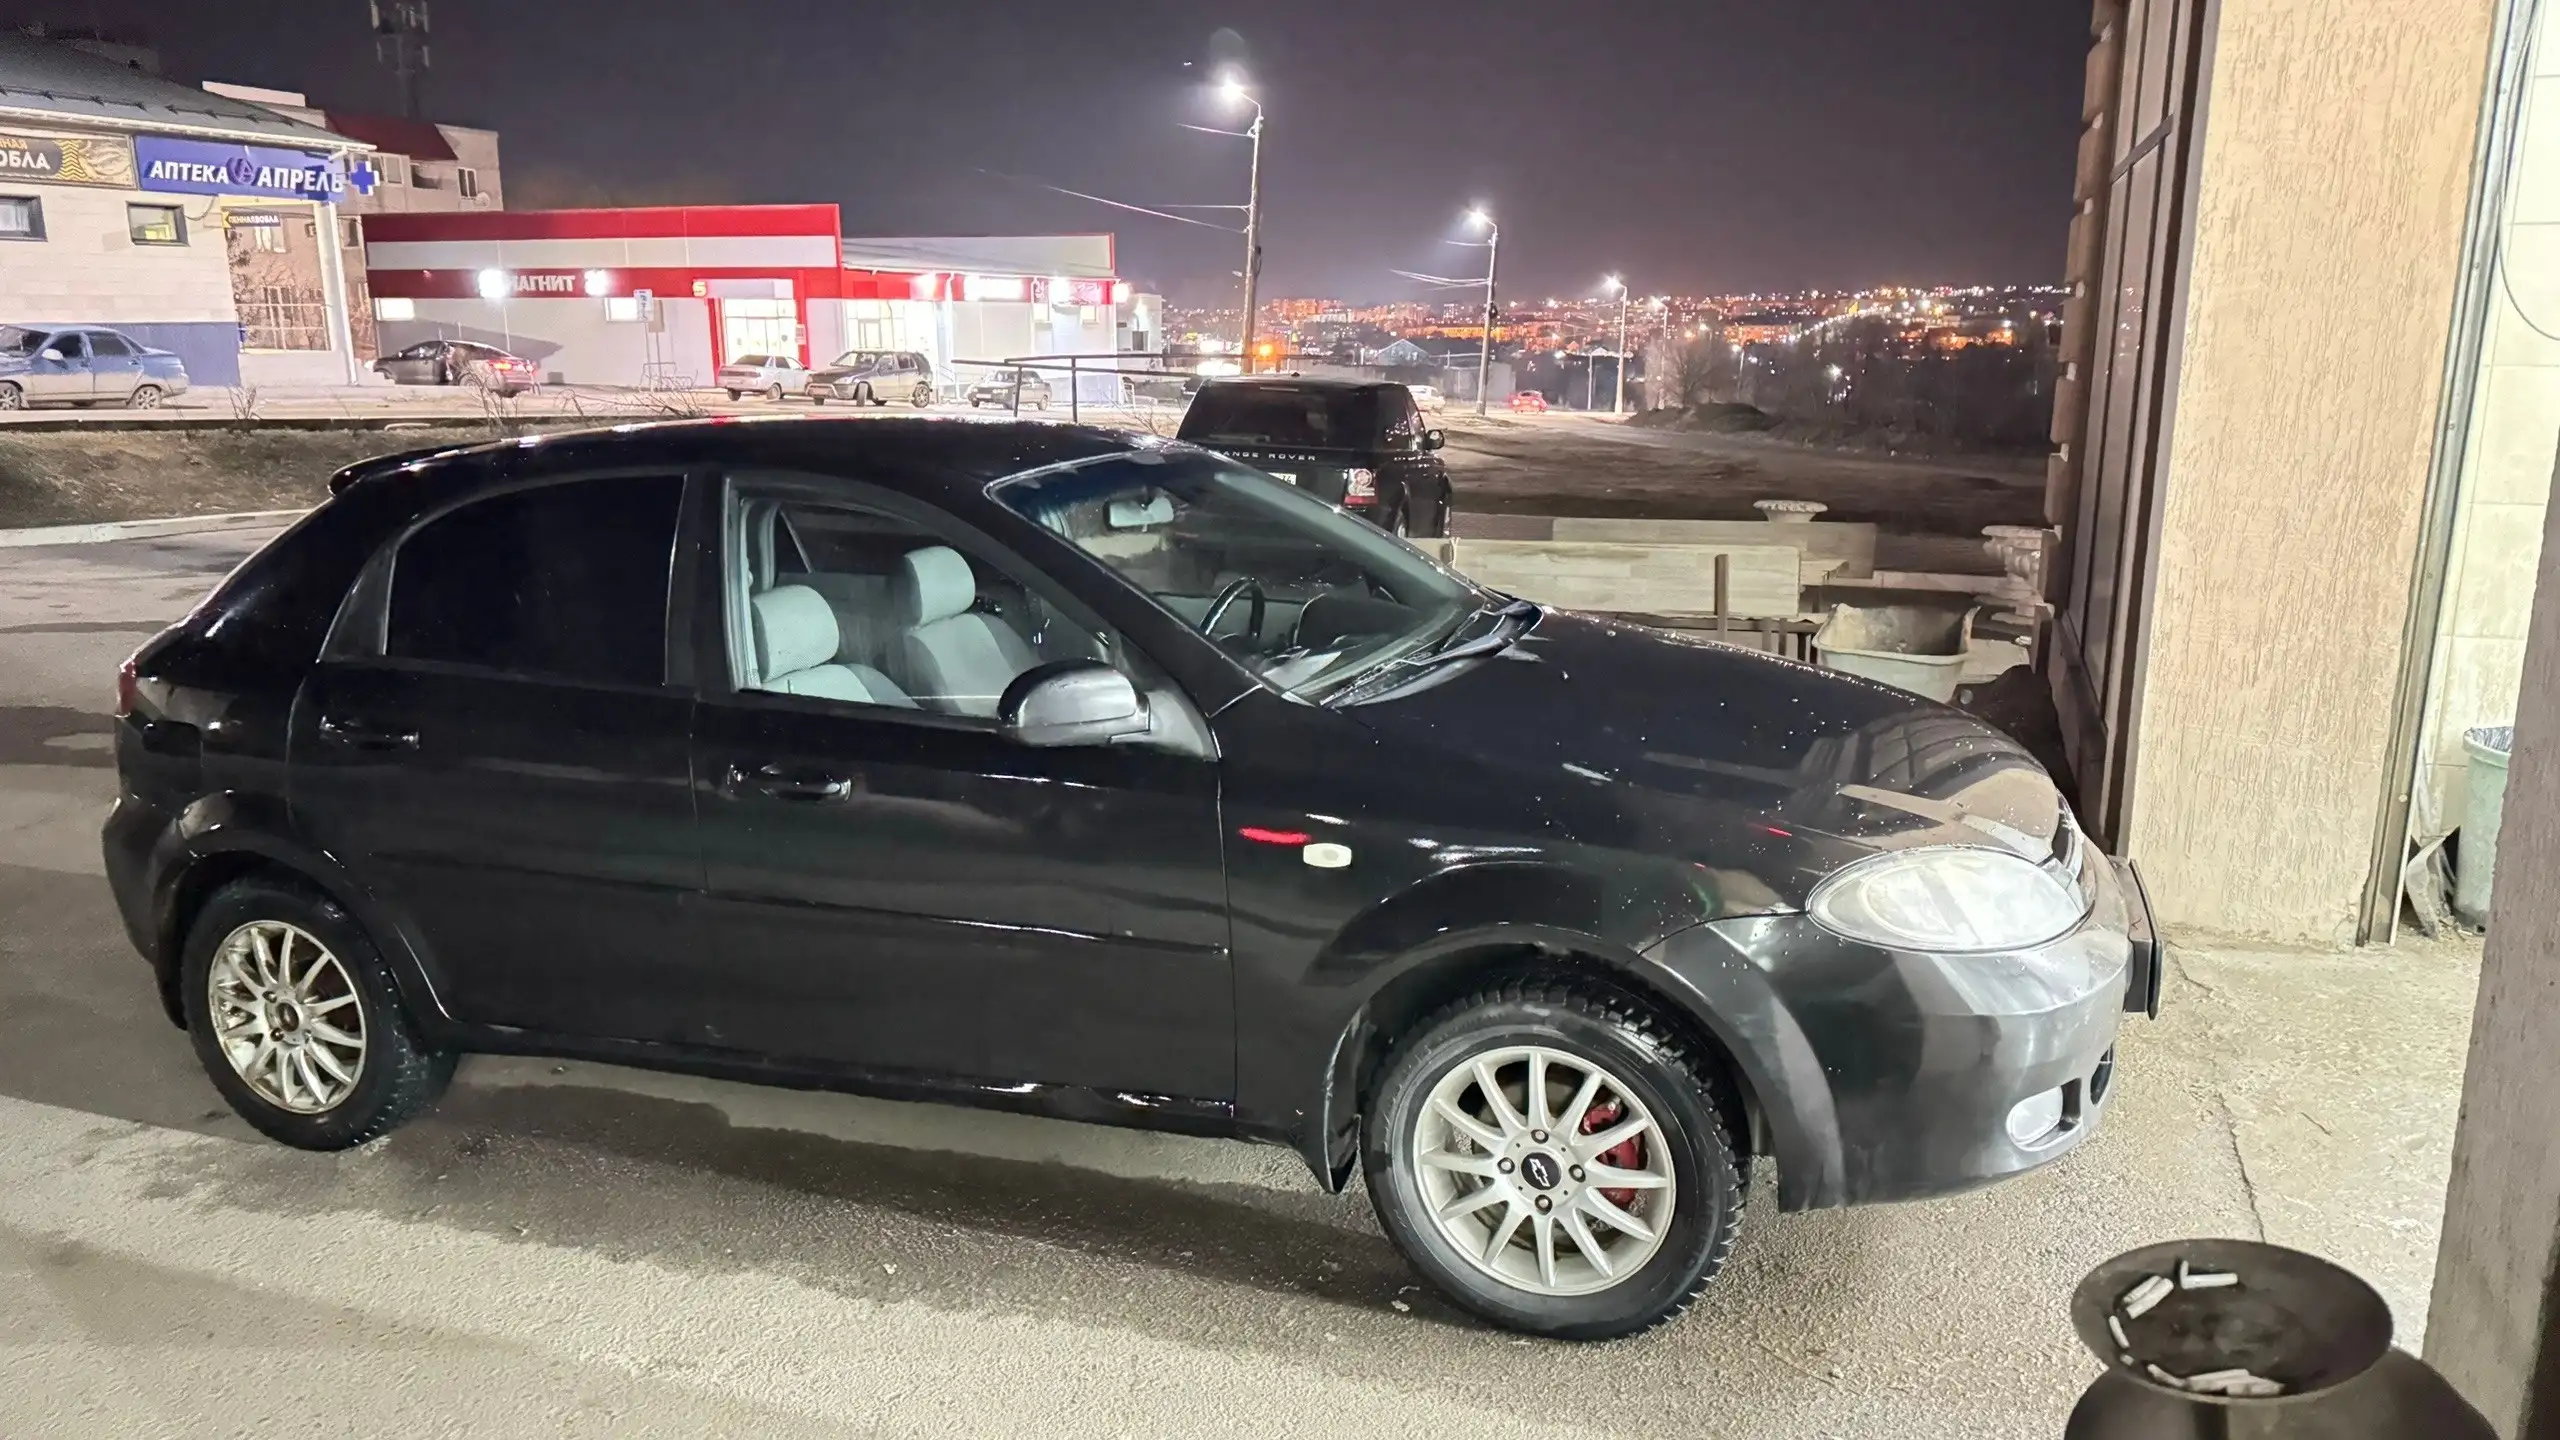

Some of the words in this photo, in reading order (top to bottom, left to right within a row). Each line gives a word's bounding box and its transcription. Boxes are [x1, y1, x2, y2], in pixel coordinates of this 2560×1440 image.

[150, 160, 229, 185] АПТЕКА
[257, 166, 344, 193] АПРЕЛЬ
[1268, 453, 1316, 461] ROVER
